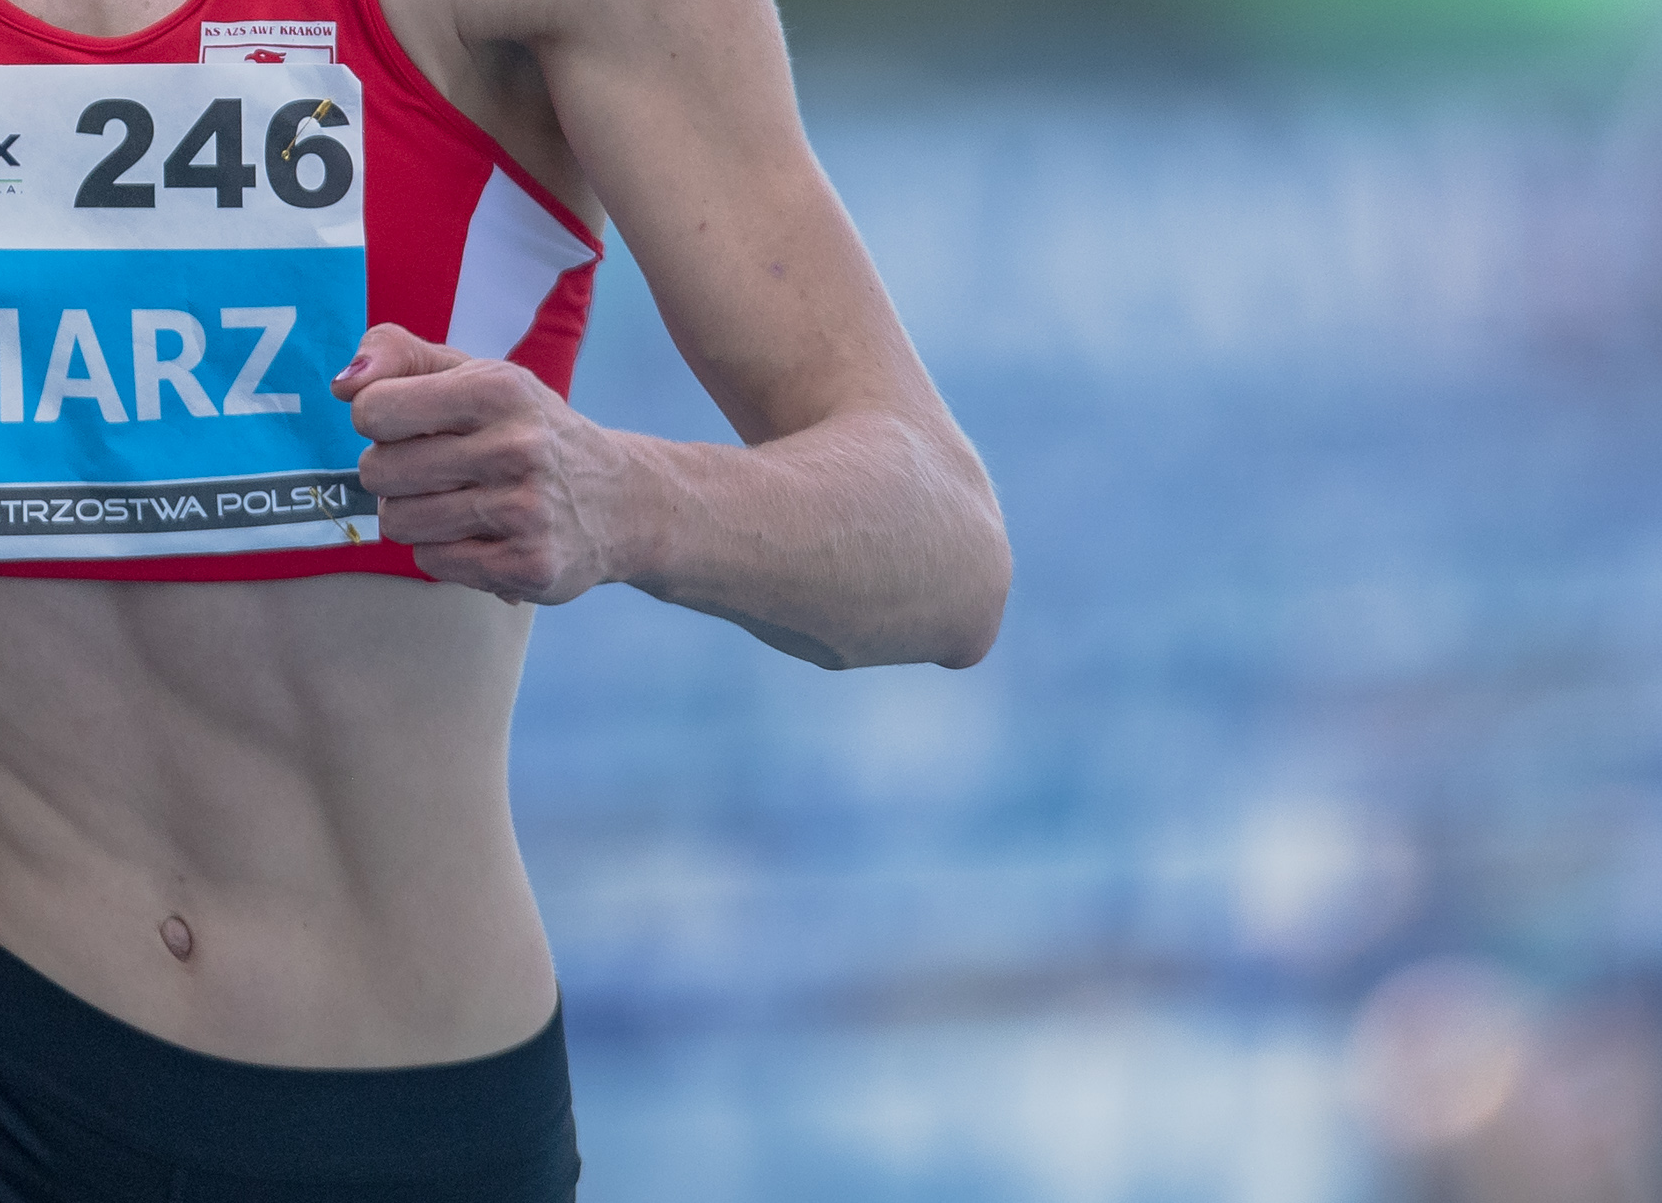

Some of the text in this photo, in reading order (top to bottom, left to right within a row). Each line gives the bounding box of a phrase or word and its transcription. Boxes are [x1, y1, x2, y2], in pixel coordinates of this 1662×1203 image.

[204, 23, 334, 36] KS AZS AWF KRAKÓW
[74, 98, 354, 209] 246
[216, 483, 348, 517] POLSKI
